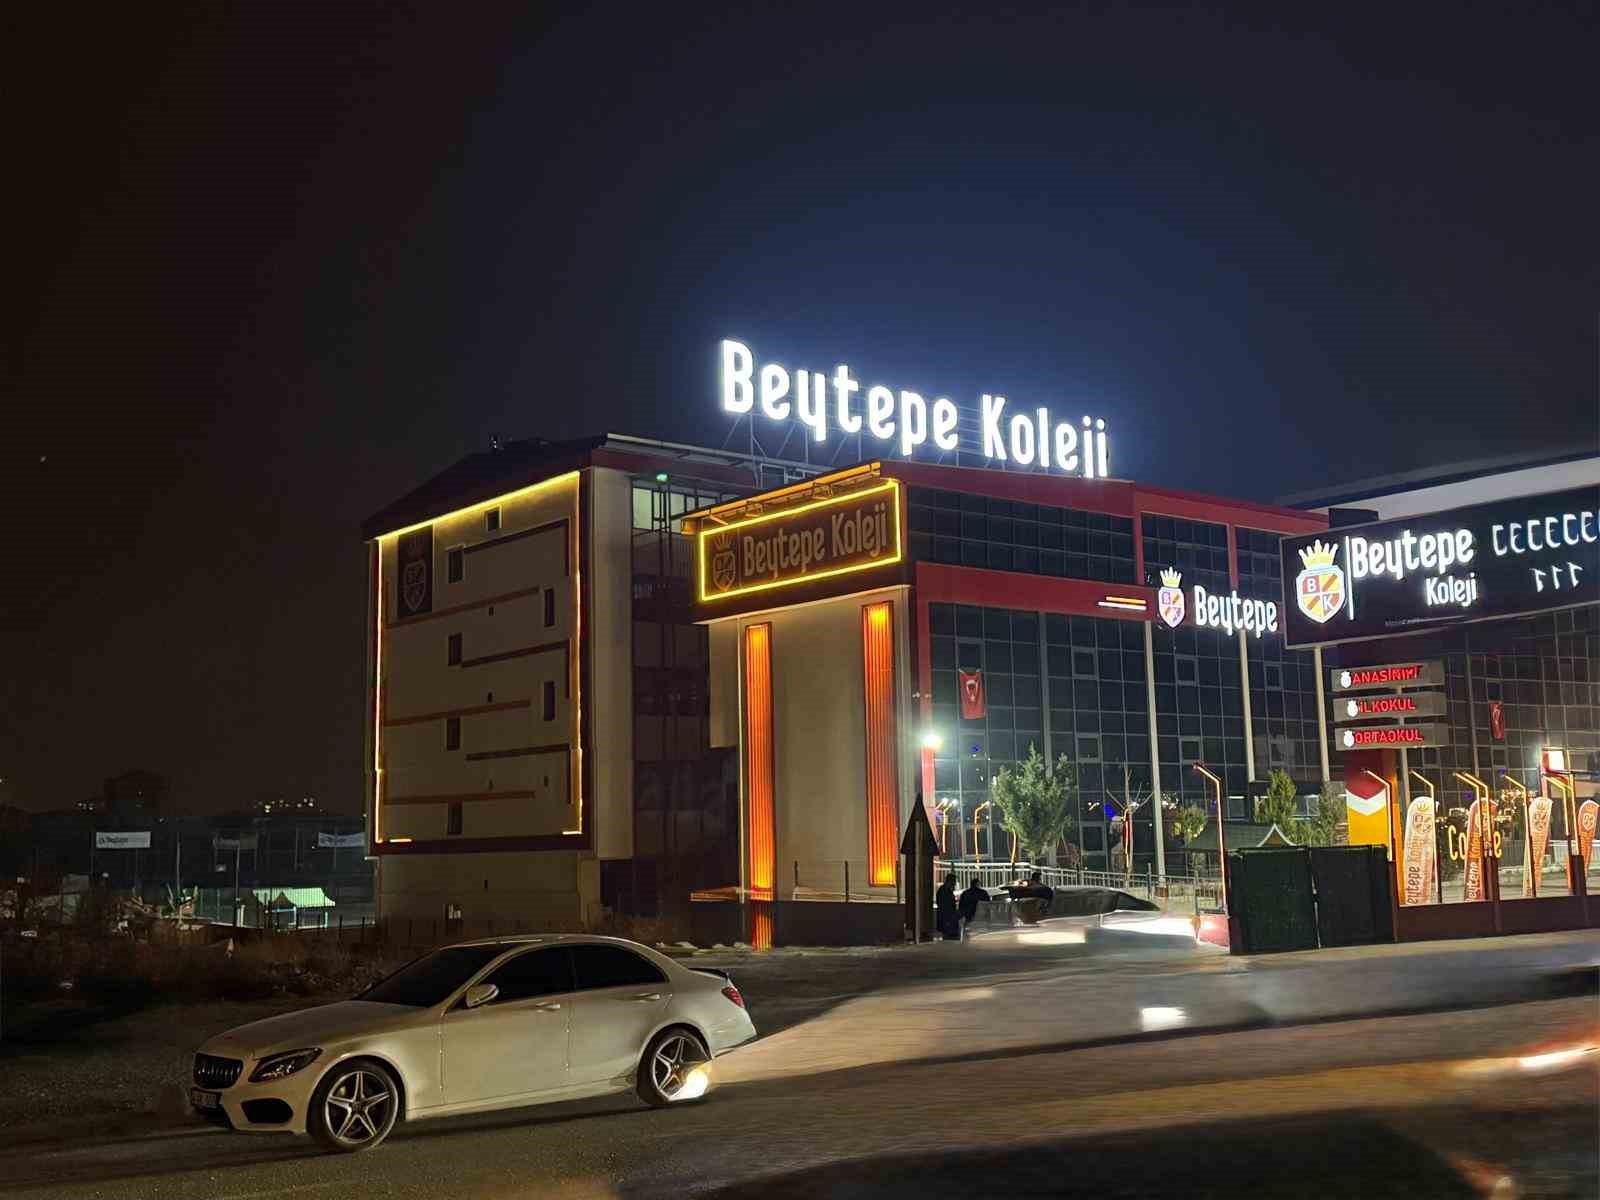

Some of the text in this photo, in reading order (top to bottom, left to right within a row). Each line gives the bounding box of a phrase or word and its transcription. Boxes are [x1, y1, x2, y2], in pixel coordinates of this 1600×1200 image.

[720, 338, 1108, 479] Beytepe Koleji
[743, 502, 888, 579] Beytepe Koleji
[1350, 529, 1475, 581] Beytepe
[1193, 585, 1279, 639] Beytepe
[1425, 572, 1478, 607] Koleji
[1354, 729, 1424, 745] ORTAOKUL
